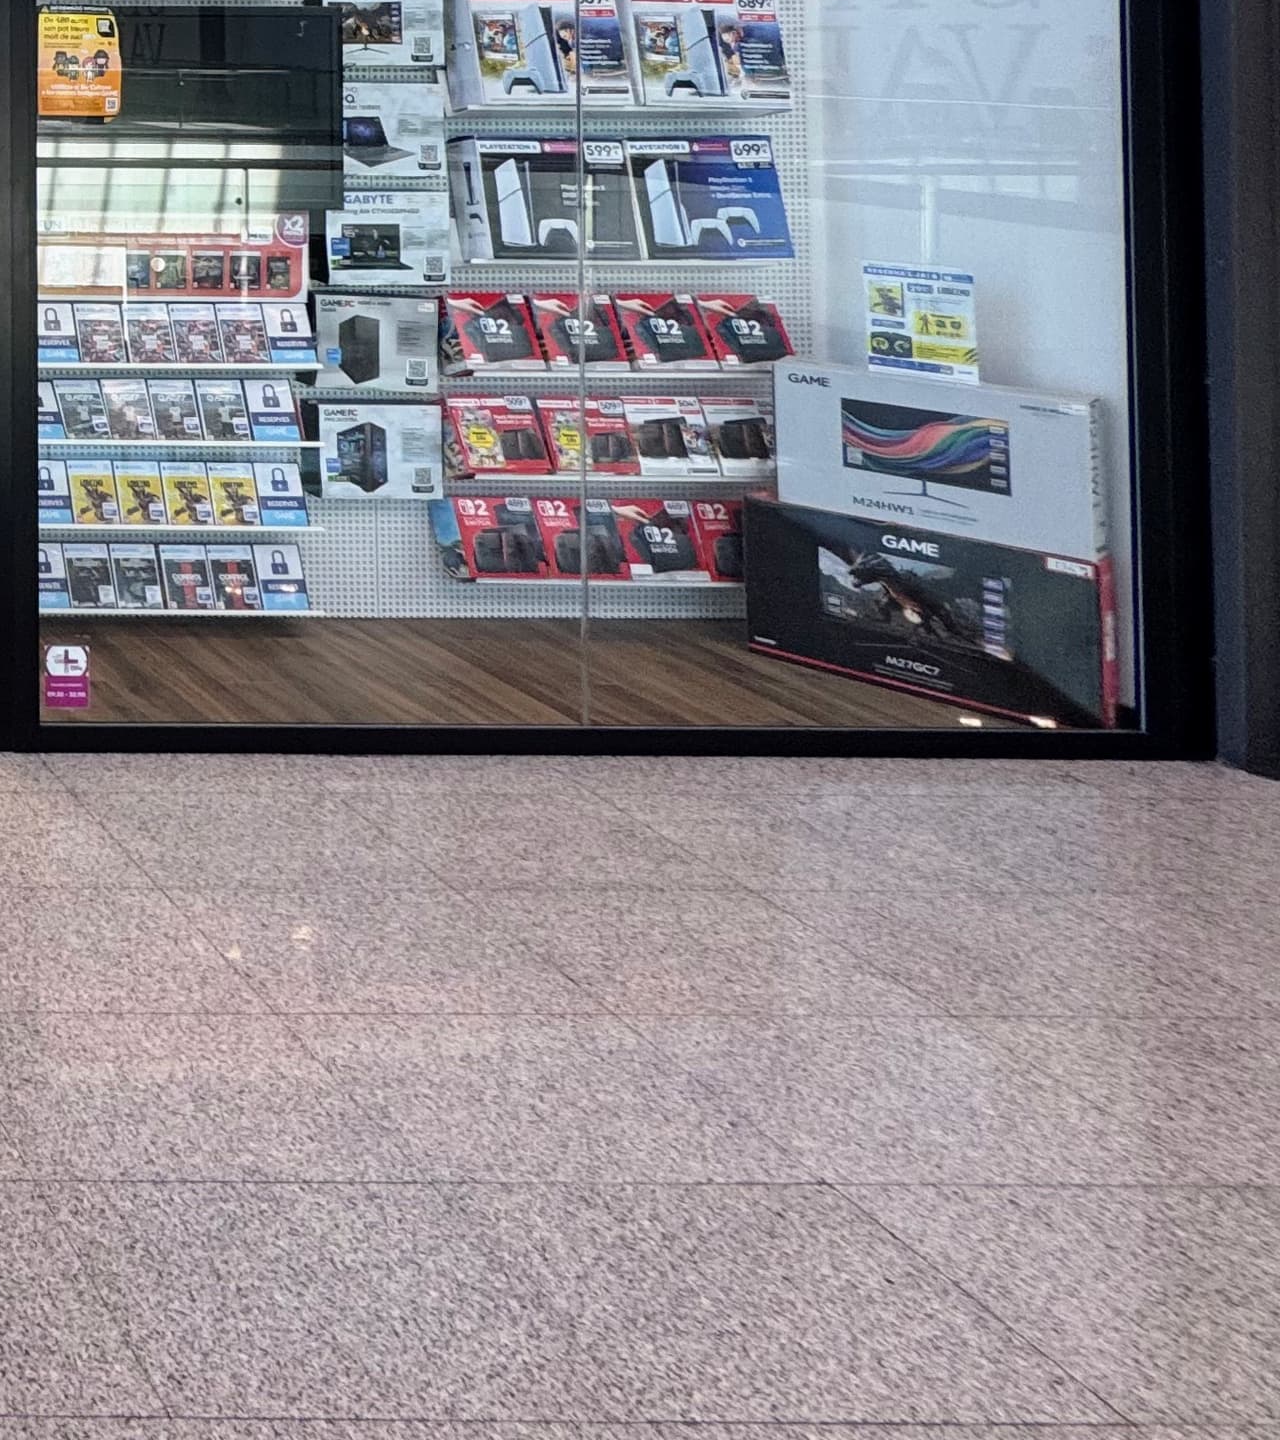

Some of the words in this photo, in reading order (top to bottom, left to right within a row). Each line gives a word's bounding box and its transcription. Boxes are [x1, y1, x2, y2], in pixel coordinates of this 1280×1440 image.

[343, 194, 393, 205] GABYTE
[496, 318, 511, 335] 2
[581, 320, 596, 336] 2
[666, 319, 683, 336] 2
[747, 319, 764, 336] 2
[787, 372, 832, 389] GAME
[473, 499, 489, 516] 2
[552, 499, 568, 516] 2
[713, 503, 729, 520] 2
[852, 495, 916, 515] M24HW1
[661, 528, 676, 545] 2
[881, 534, 940, 558] GAME
[885, 655, 940, 676] M27GC7
